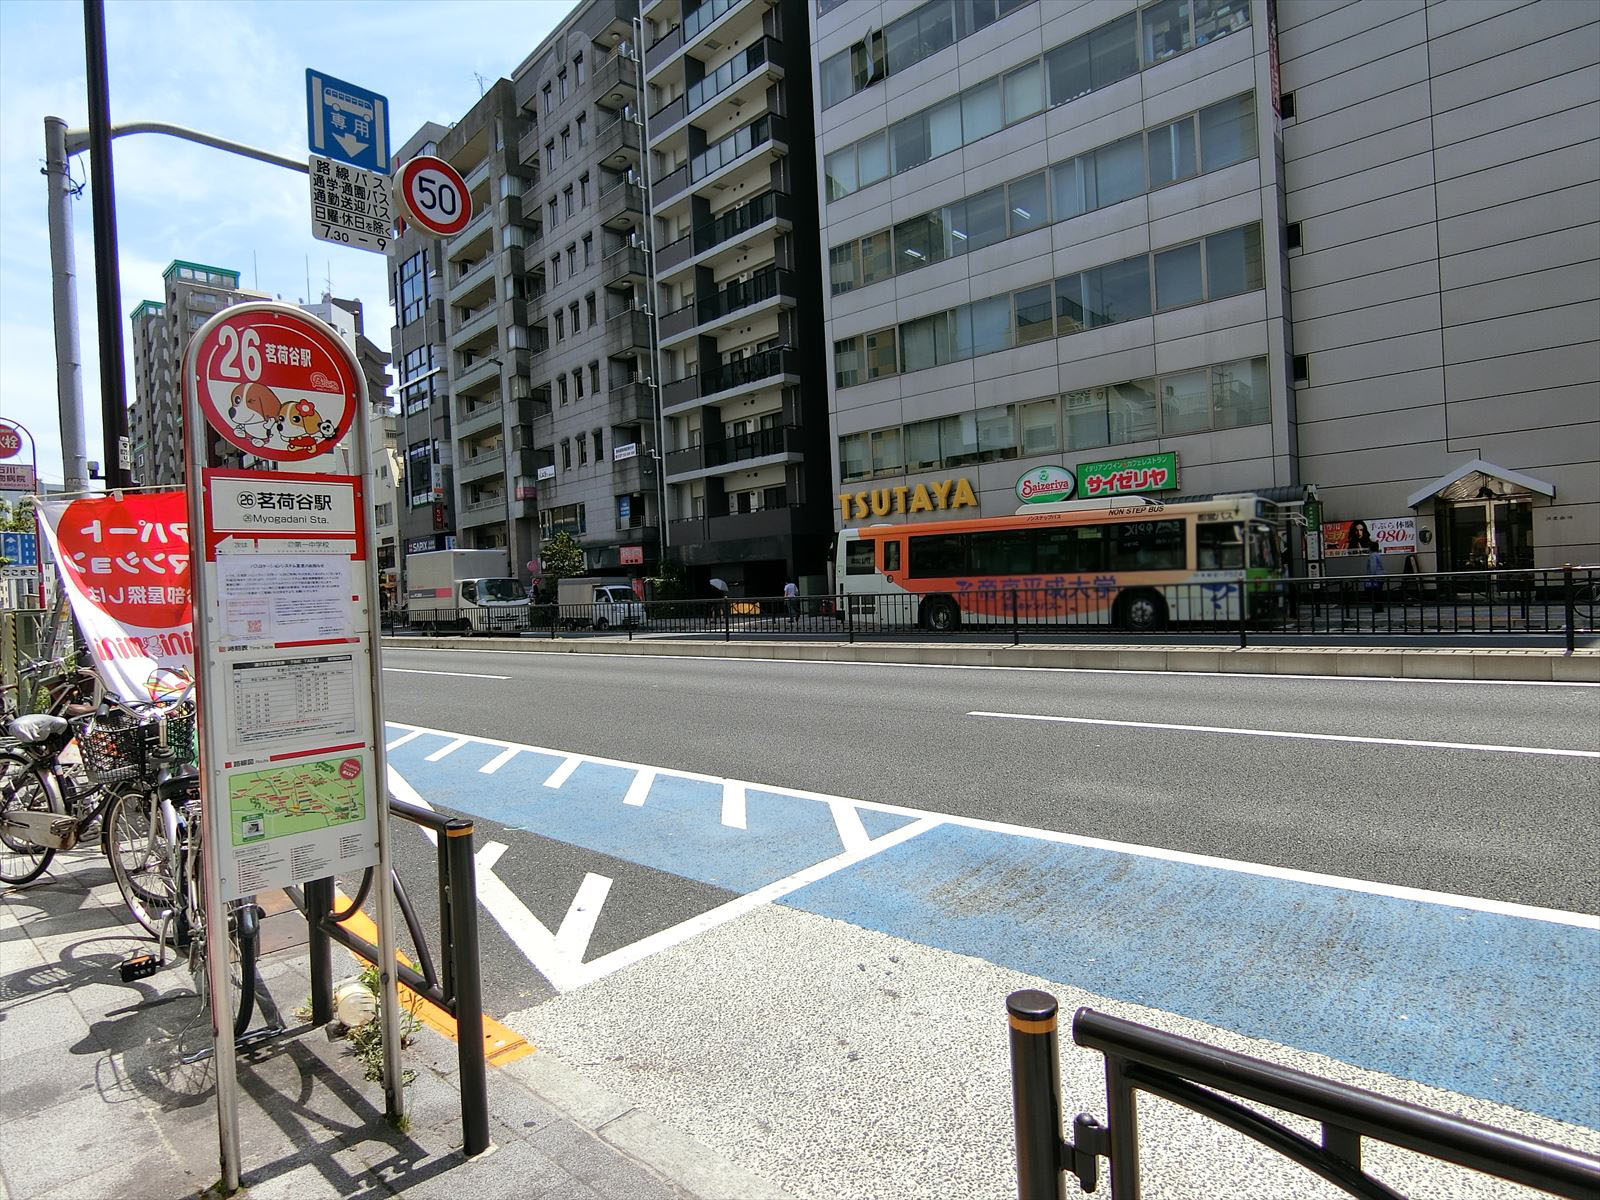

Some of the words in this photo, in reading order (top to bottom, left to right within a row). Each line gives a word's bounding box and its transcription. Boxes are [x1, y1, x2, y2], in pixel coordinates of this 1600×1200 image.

[331, 112, 369, 138] 専用
[316, 159, 386, 192] 路線バス
[313, 188, 391, 220] 通勤送迎バス
[418, 175, 457, 216] 50
[320, 223, 349, 243] 7.30
[376, 238, 387, 251] 9
[218, 325, 262, 382] 26
[265, 343, 312, 368] 茗荷谷駅
[1021, 478, 1069, 498] Saizeriya
[1086, 468, 1167, 494] サイゼリヤ
[838, 478, 978, 521] TSUTAYA
[1108, 507, 1125, 516] NON
[1126, 506, 1147, 515] STEP
[1148, 505, 1164, 513] BUS
[310, 515, 330, 524] Sta.
